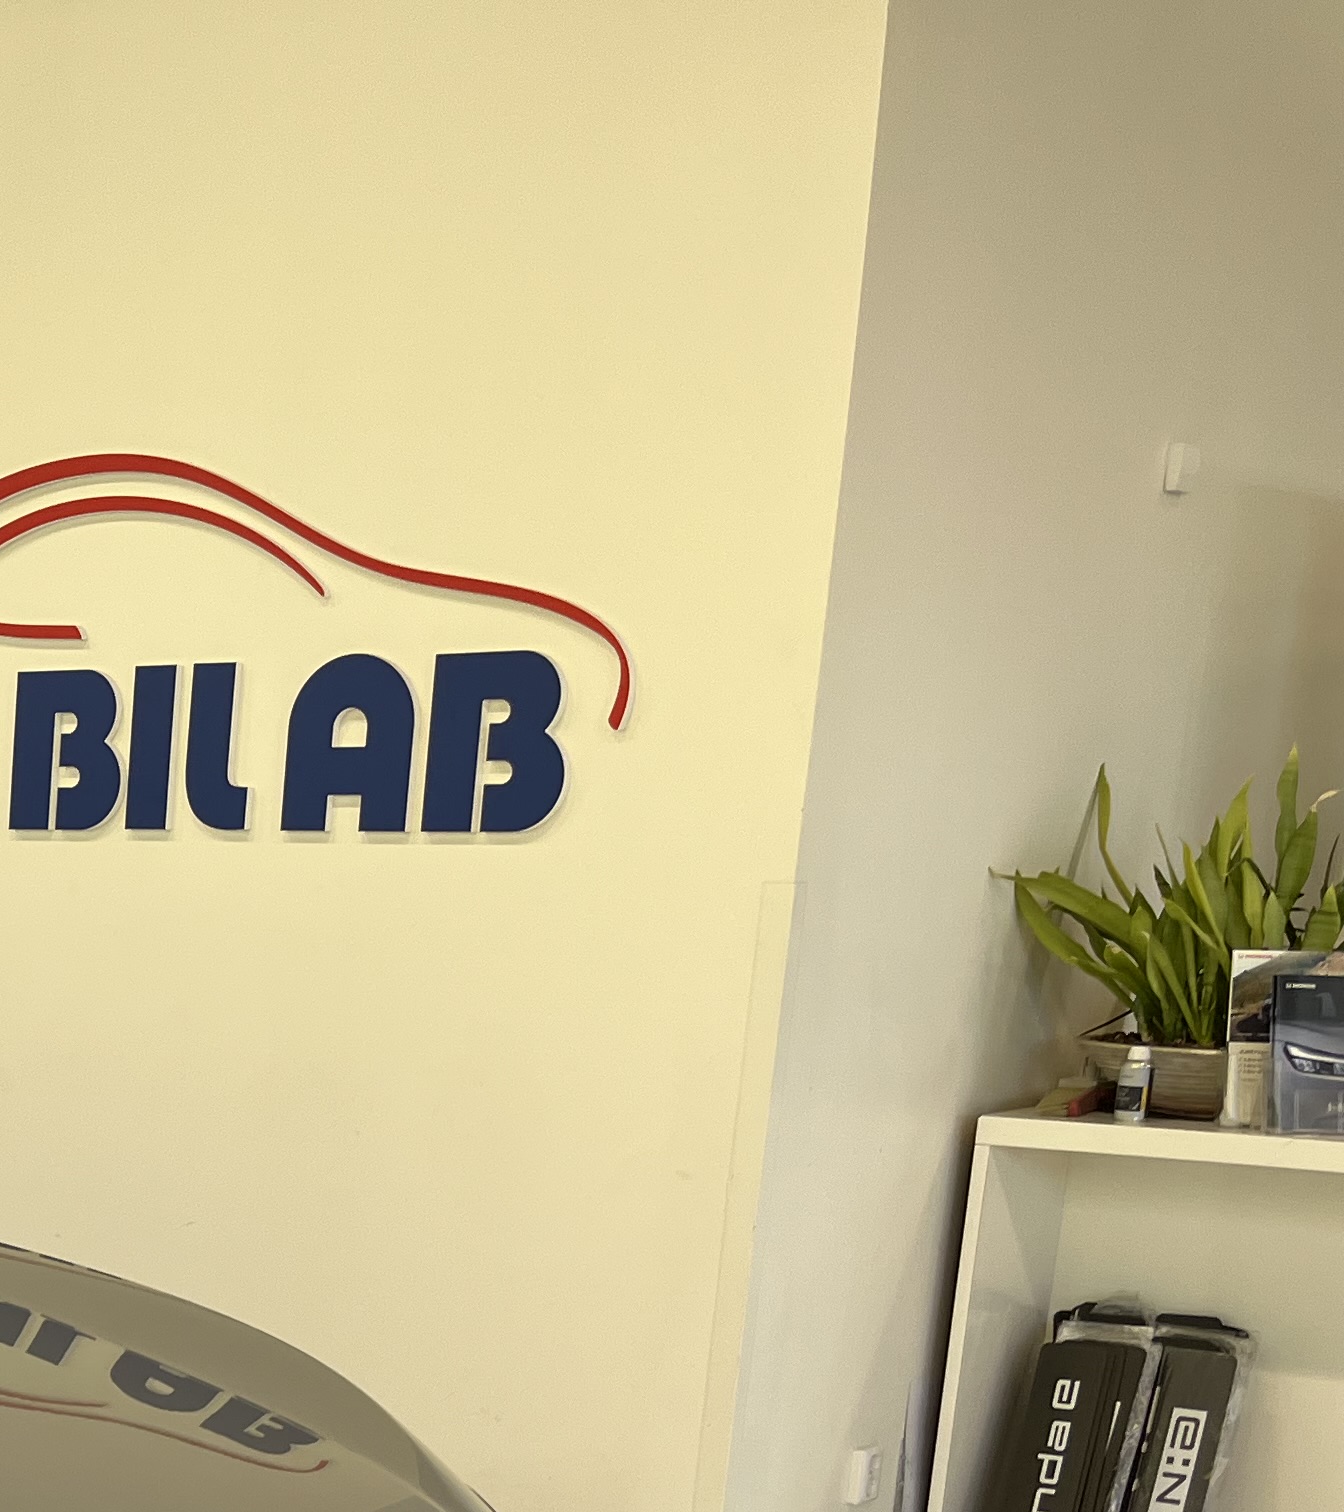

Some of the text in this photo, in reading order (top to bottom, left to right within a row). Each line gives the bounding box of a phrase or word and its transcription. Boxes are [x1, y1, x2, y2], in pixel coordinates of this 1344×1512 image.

[9, 664, 250, 830] BIL
[281, 651, 565, 832] AB
[1051, 1378, 1081, 1411] e
